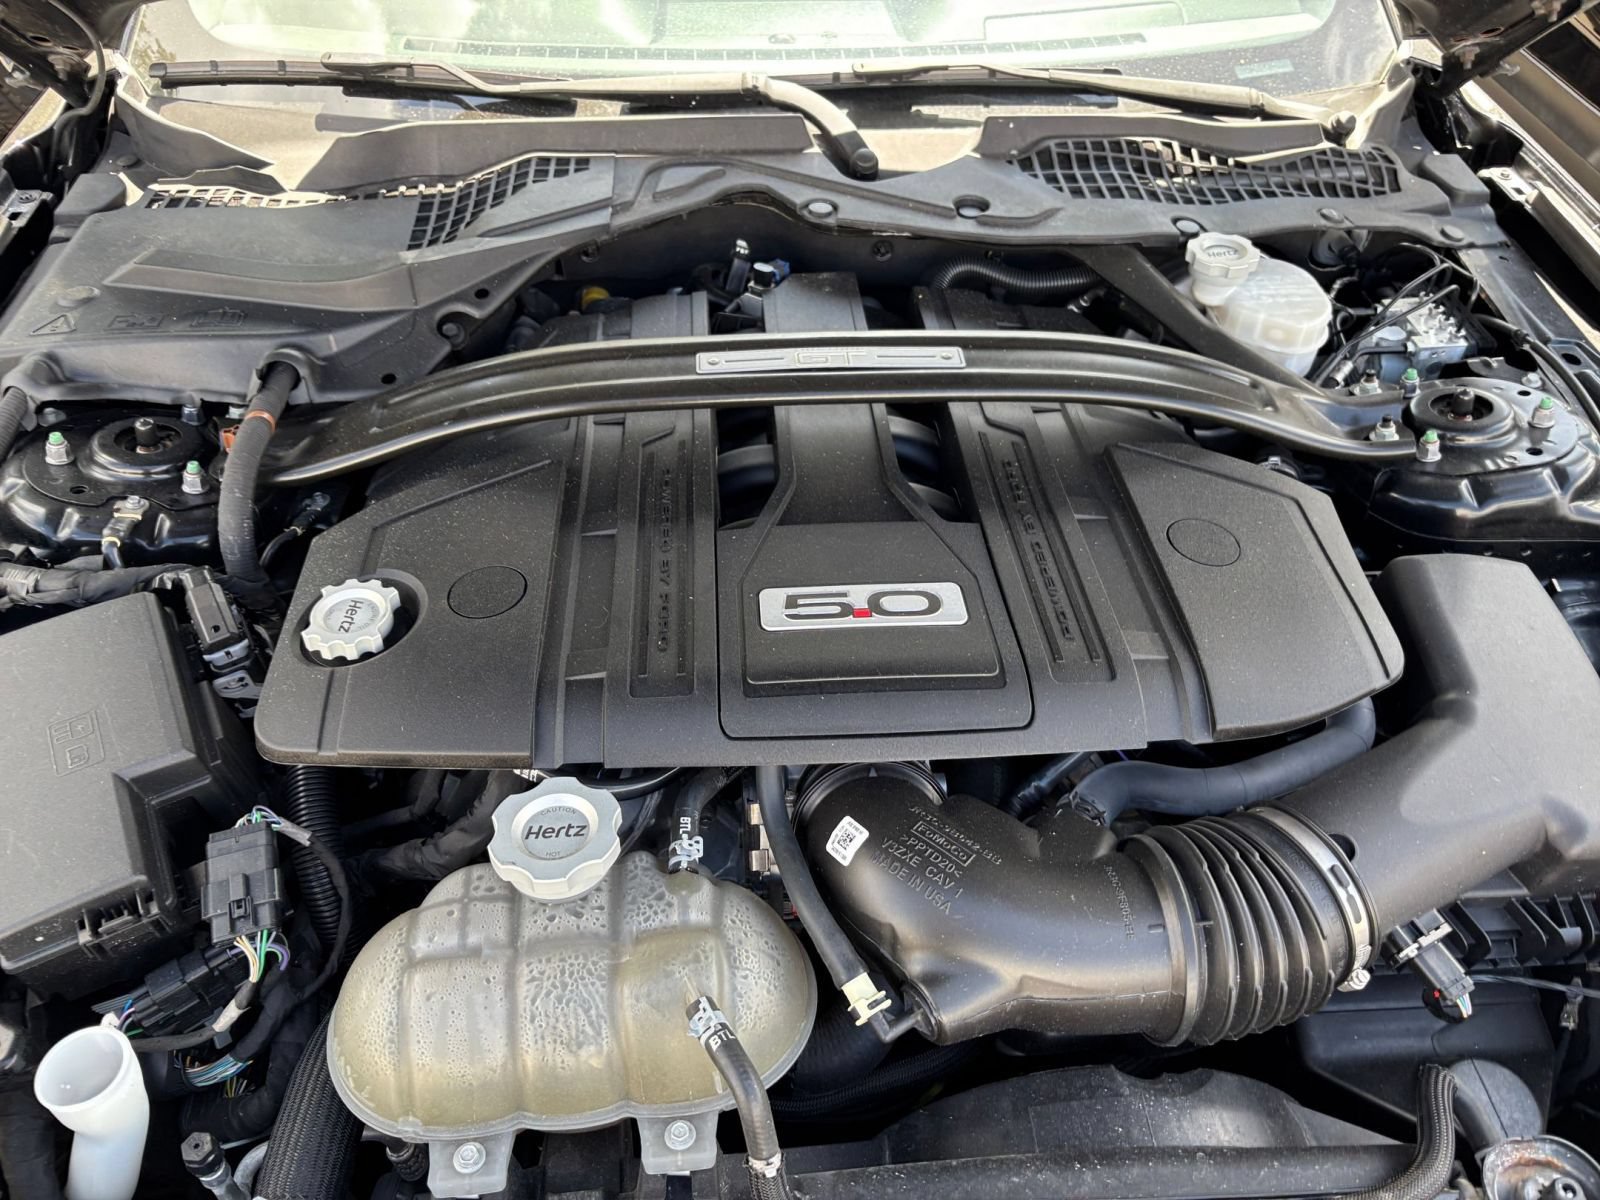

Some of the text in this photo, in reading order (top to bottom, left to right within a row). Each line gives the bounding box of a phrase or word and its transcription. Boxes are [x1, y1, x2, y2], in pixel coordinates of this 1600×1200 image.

[1208, 249, 1239, 259] Hertz
[795, 350, 867, 366] GT
[338, 599, 364, 633] Hertz
[784, 590, 942, 621] 5.0
[540, 806, 577, 816] CAUTION
[524, 823, 588, 840] Hertz
[917, 824, 968, 860] FoMoCo
[871, 850, 910, 881] MADE
[908, 874, 925, 892] IN
[924, 886, 952, 915] USA
[925, 866, 955, 889] CAV
[708, 1028, 737, 1052] BTL
